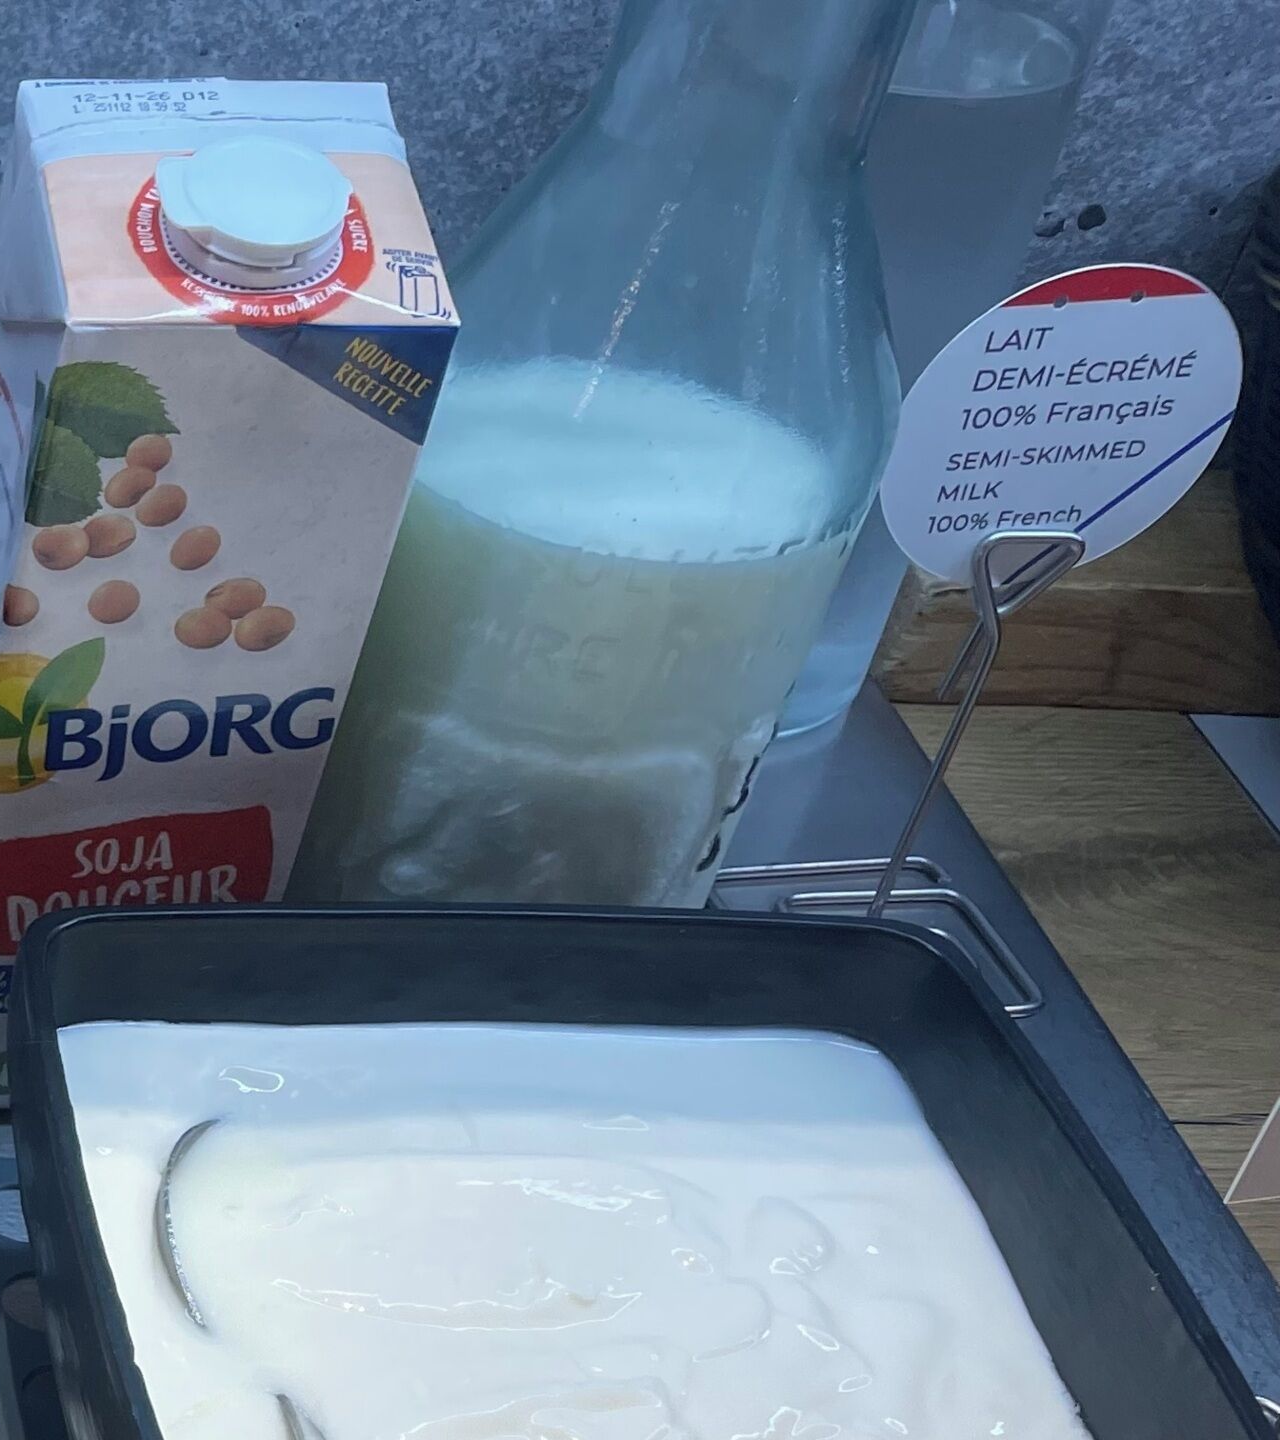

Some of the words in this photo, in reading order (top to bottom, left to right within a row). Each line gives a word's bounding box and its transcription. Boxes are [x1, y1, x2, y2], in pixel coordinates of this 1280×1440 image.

[985, 326, 1054, 354] LAIT
[344, 336, 433, 399] NOUVELLE
[972, 351, 1198, 393] DEMI-ÉCRÉMÉ
[332, 360, 407, 417] RECETTE
[961, 404, 1037, 430] 100%
[1045, 396, 1175, 426] Français
[945, 440, 1146, 472] SEMI-SKIMMED
[937, 481, 1003, 504] MILK
[927, 513, 989, 535] 100%
[996, 505, 1083, 528] French
[71, 831, 174, 880] SOJA
